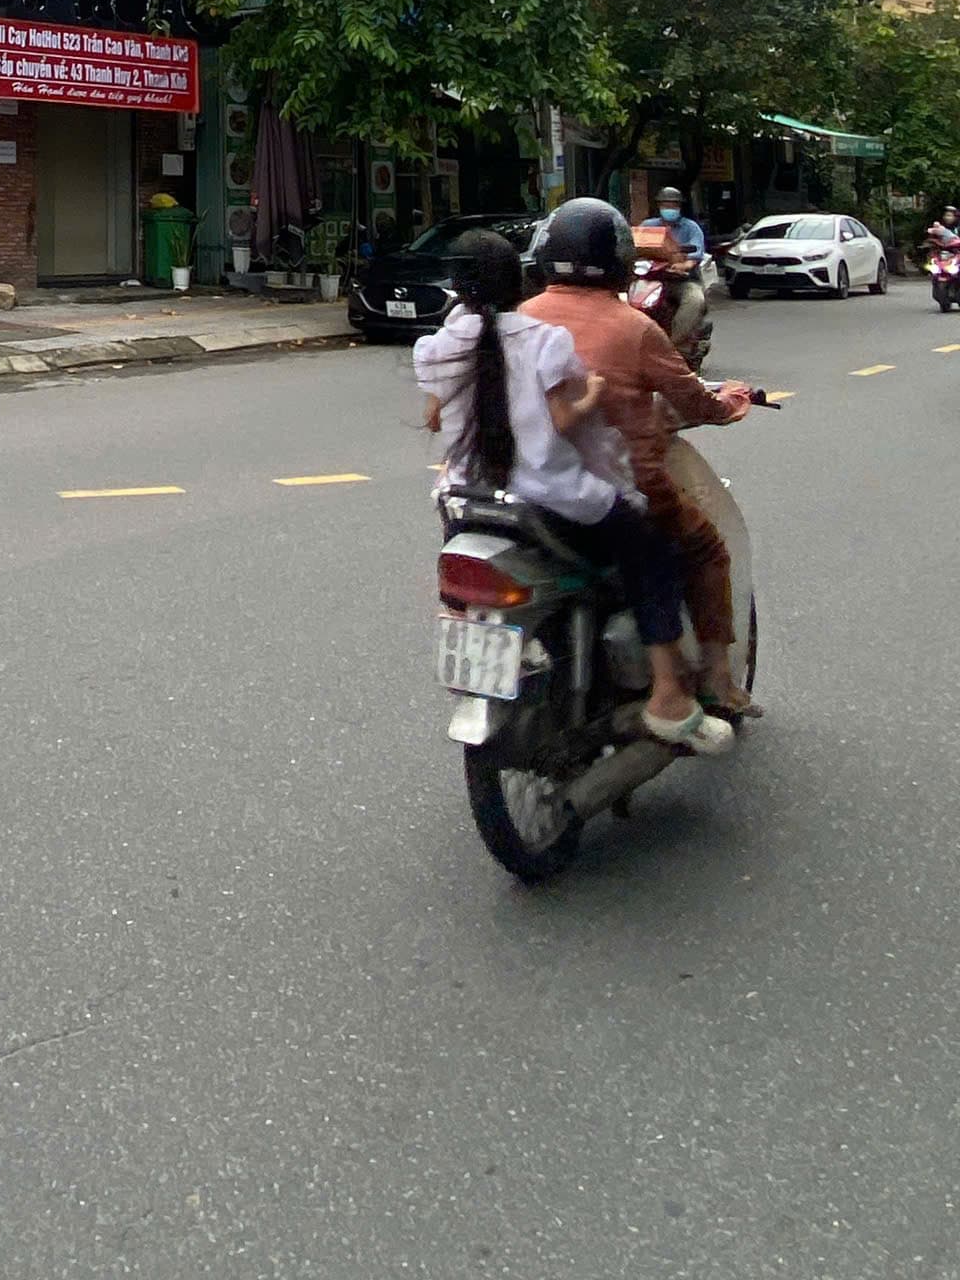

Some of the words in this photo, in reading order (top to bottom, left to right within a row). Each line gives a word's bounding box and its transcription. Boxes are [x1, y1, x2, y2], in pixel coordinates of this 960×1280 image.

[8, 26, 27, 48] Cay
[29, 28, 61, 50] HotHot
[63, 32, 80, 51] 523
[105, 37, 122, 55] Cao
[145, 42, 171, 61] Thanh
[16, 56, 52, 78] chuyển
[71, 63, 83, 81] 43
[84, 65, 112, 83] Thanh
[114, 67, 131, 87] Huy
[144, 70, 169, 88] Thanh
